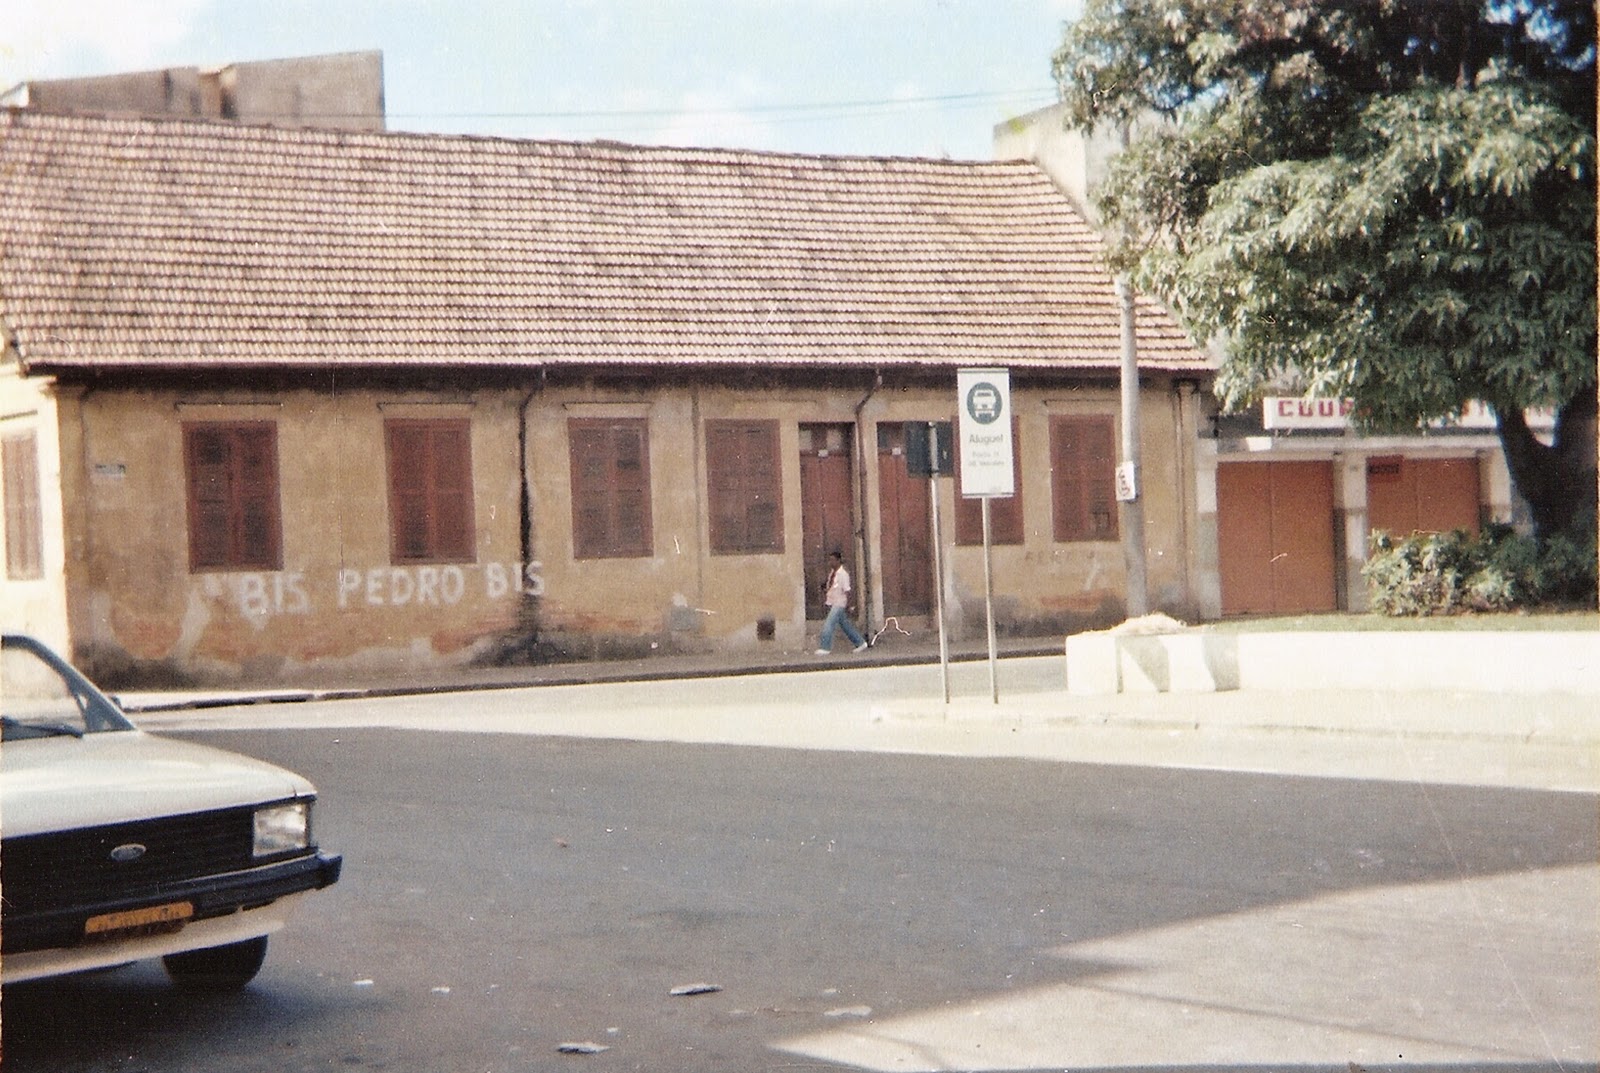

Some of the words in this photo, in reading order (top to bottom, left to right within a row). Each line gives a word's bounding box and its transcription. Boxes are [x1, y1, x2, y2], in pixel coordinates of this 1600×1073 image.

[969, 433, 1004, 446] Aluguel
[337, 565, 465, 608] PEDRO
[486, 561, 545, 599] BIS
